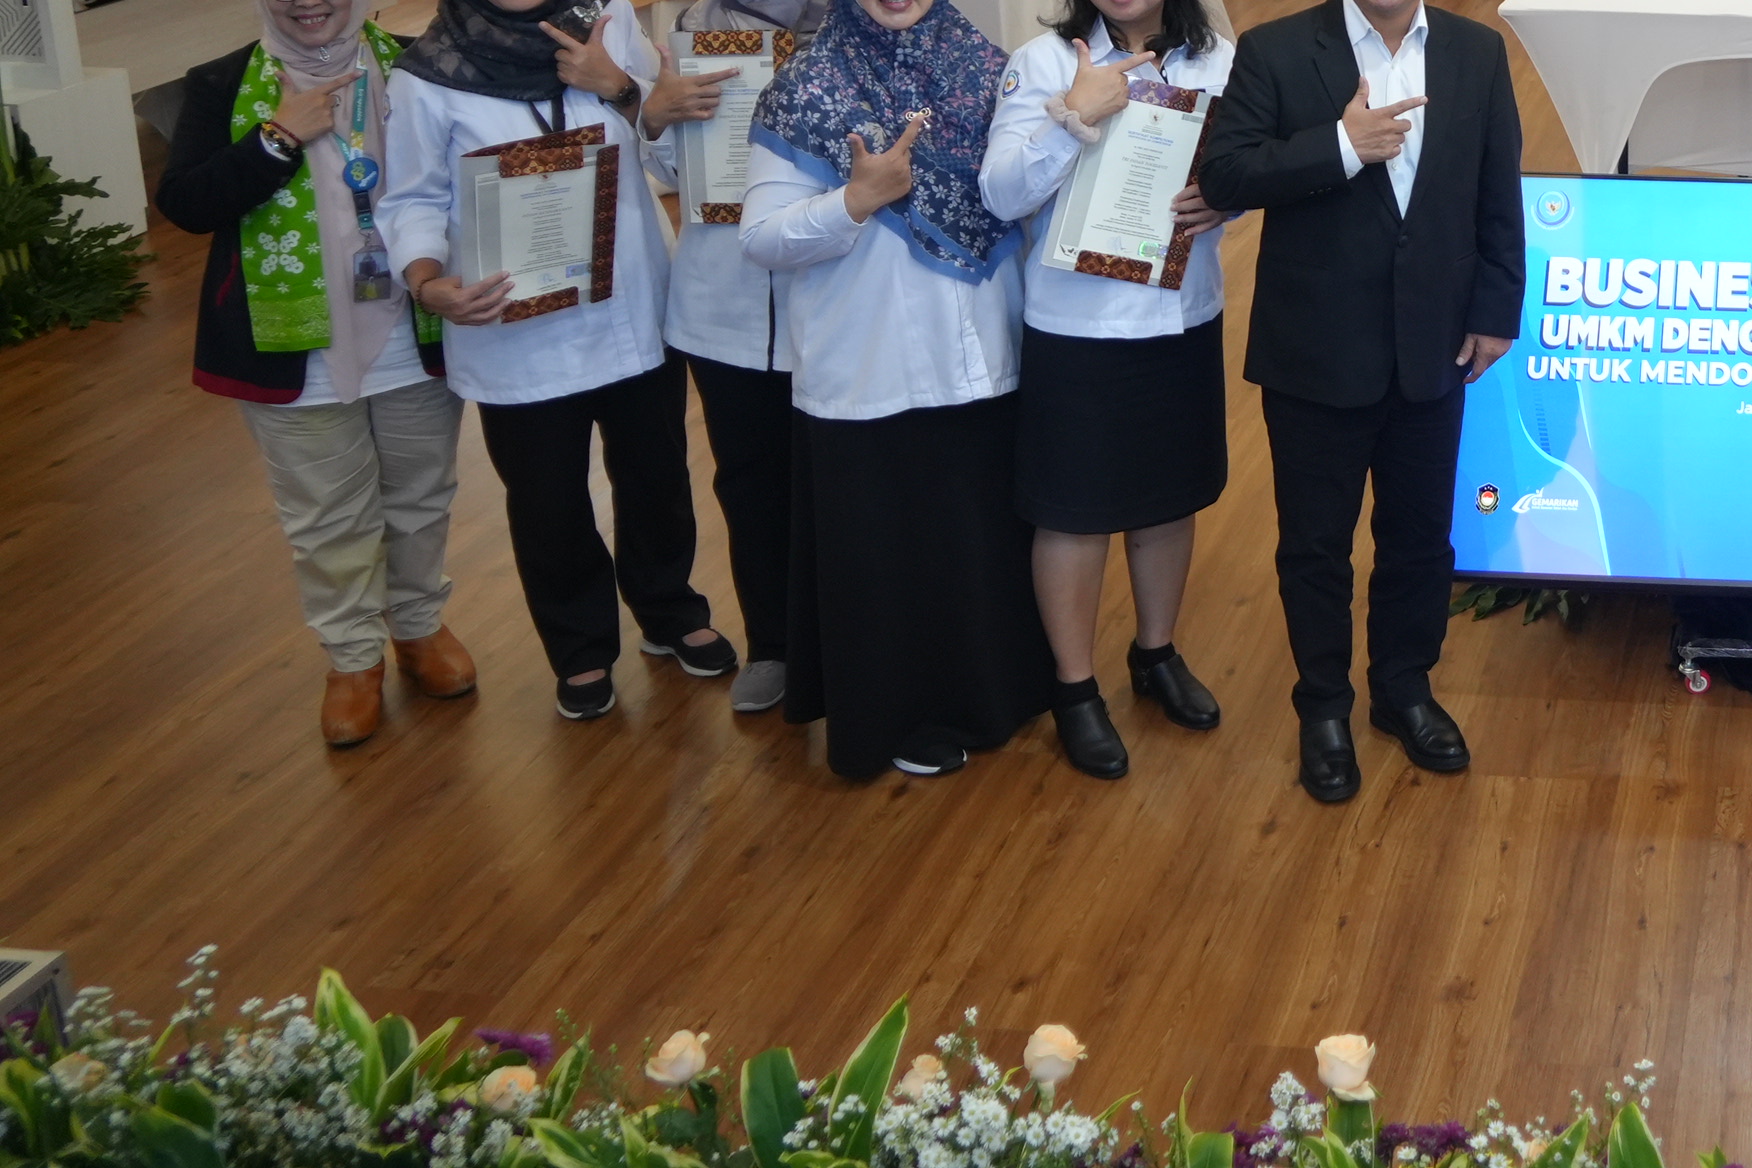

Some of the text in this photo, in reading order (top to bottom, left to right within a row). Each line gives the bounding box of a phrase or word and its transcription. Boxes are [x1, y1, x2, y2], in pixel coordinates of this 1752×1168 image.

[1540, 313, 1655, 352] UMKM
[1526, 355, 1633, 382] UNTUK
[1531, 497, 1579, 507] GEMARIKAN
